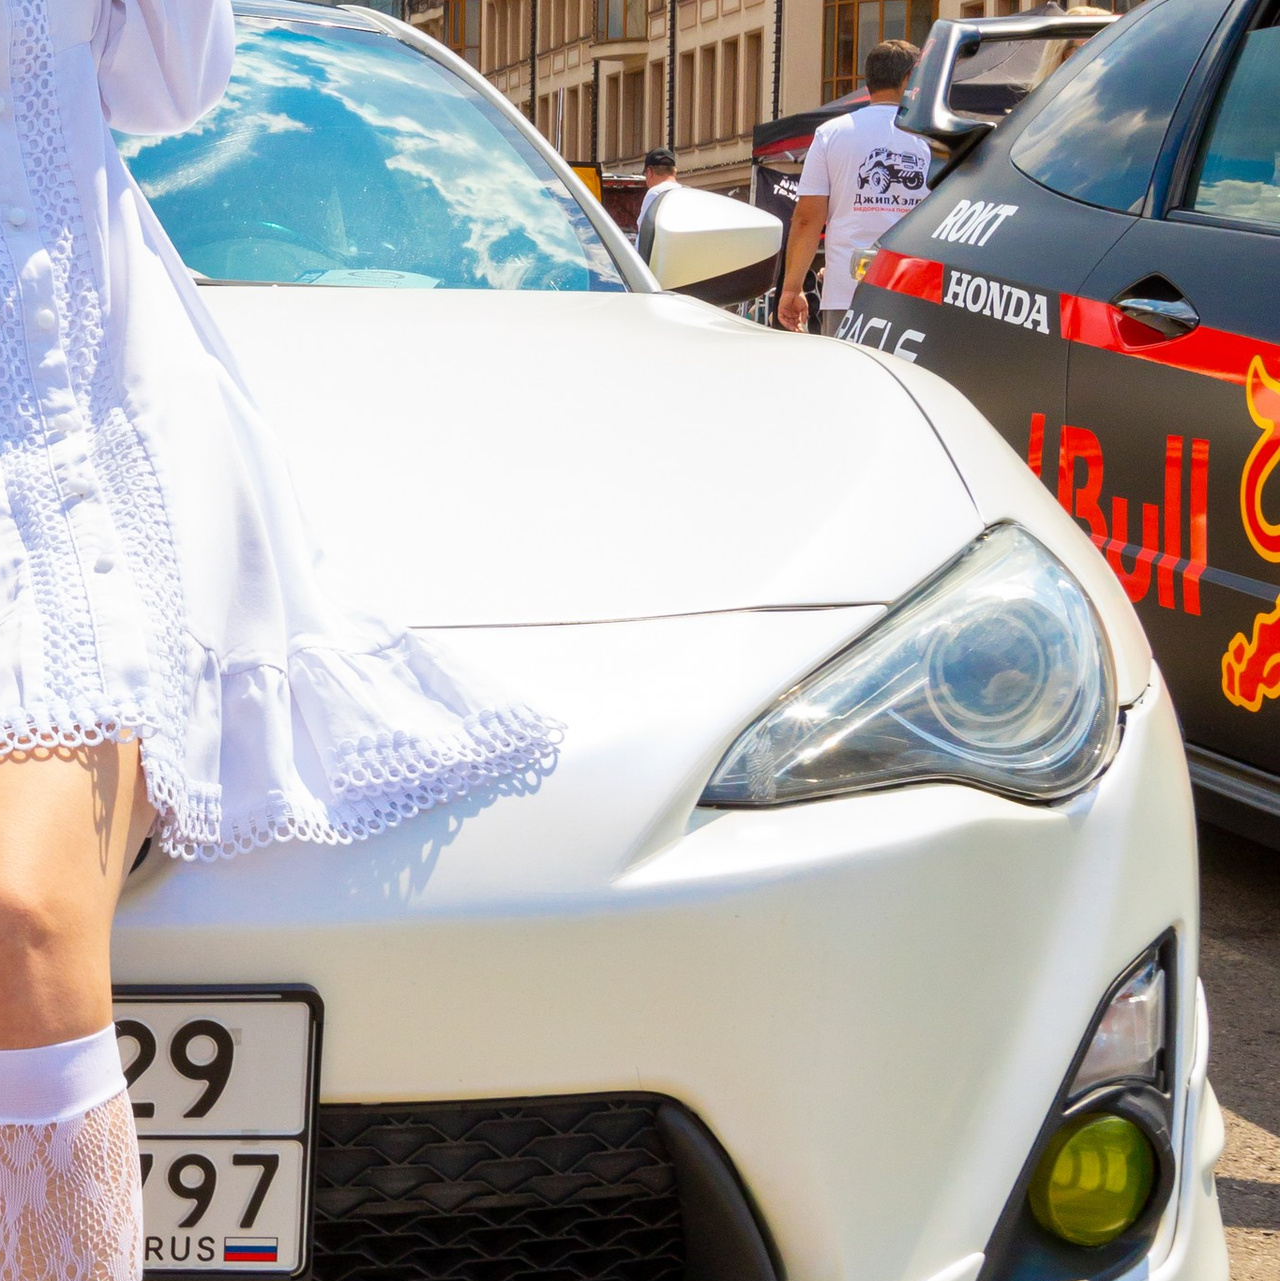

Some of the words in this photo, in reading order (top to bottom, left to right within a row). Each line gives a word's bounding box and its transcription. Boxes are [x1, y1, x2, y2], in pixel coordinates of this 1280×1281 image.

[931, 199, 1020, 247] ROKT
[943, 270, 1051, 335] HONDA
[1057, 424, 1210, 616] Bull
[115, 1019, 235, 1119] 29
[144, 1236, 216, 1262] RUS
